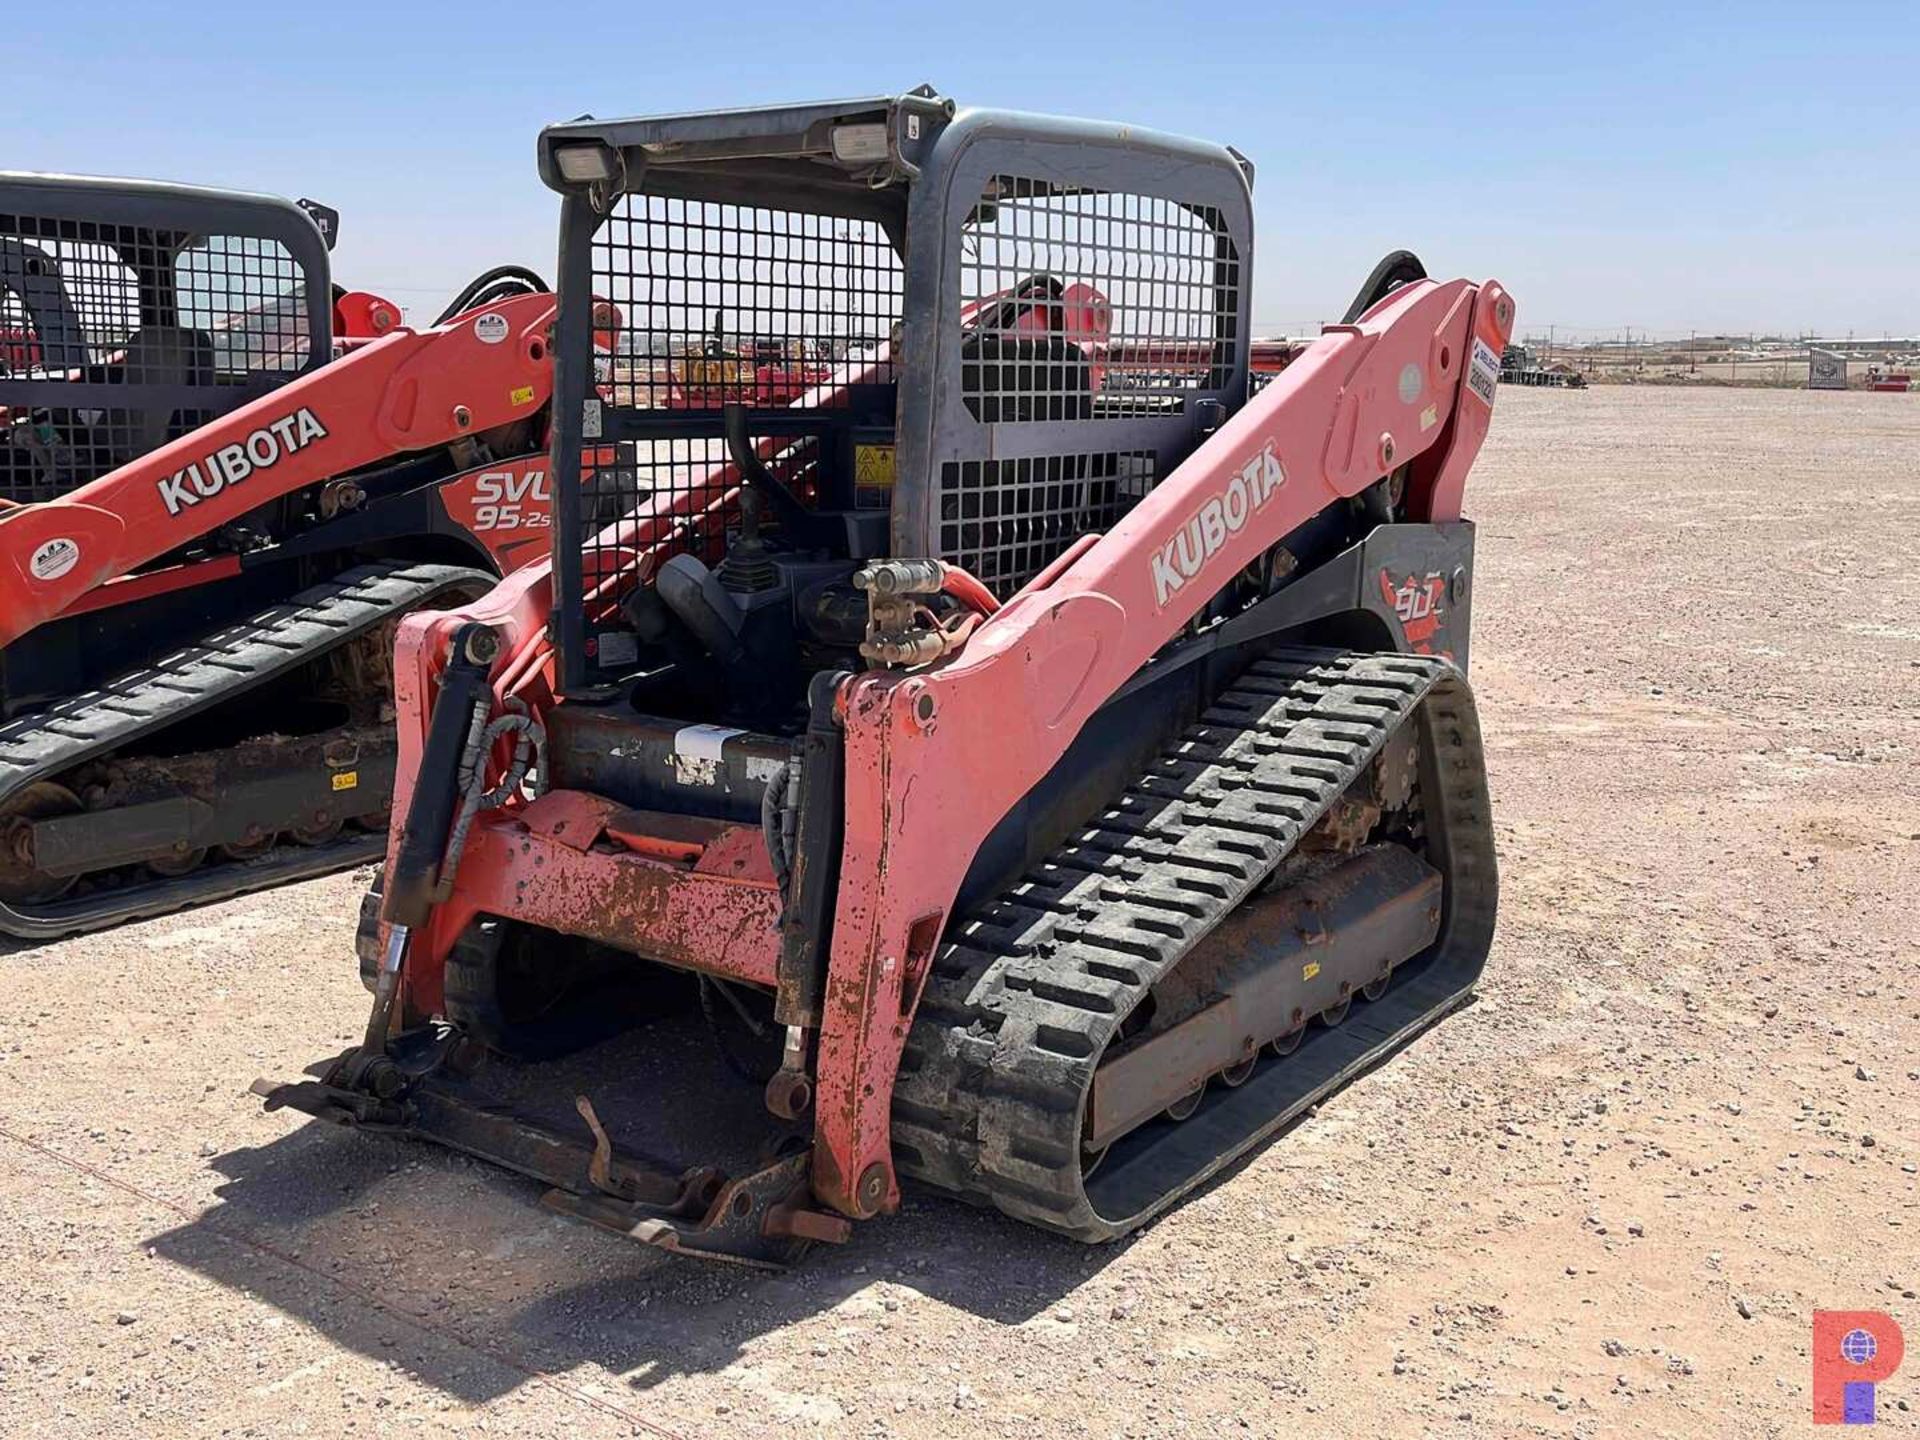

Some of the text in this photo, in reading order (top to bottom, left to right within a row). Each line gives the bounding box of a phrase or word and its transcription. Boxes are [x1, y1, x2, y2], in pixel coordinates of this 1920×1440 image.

[157, 407, 327, 516] KUBOTA
[470, 471, 551, 504] SVL
[1151, 445, 1286, 608] KUBOTA
